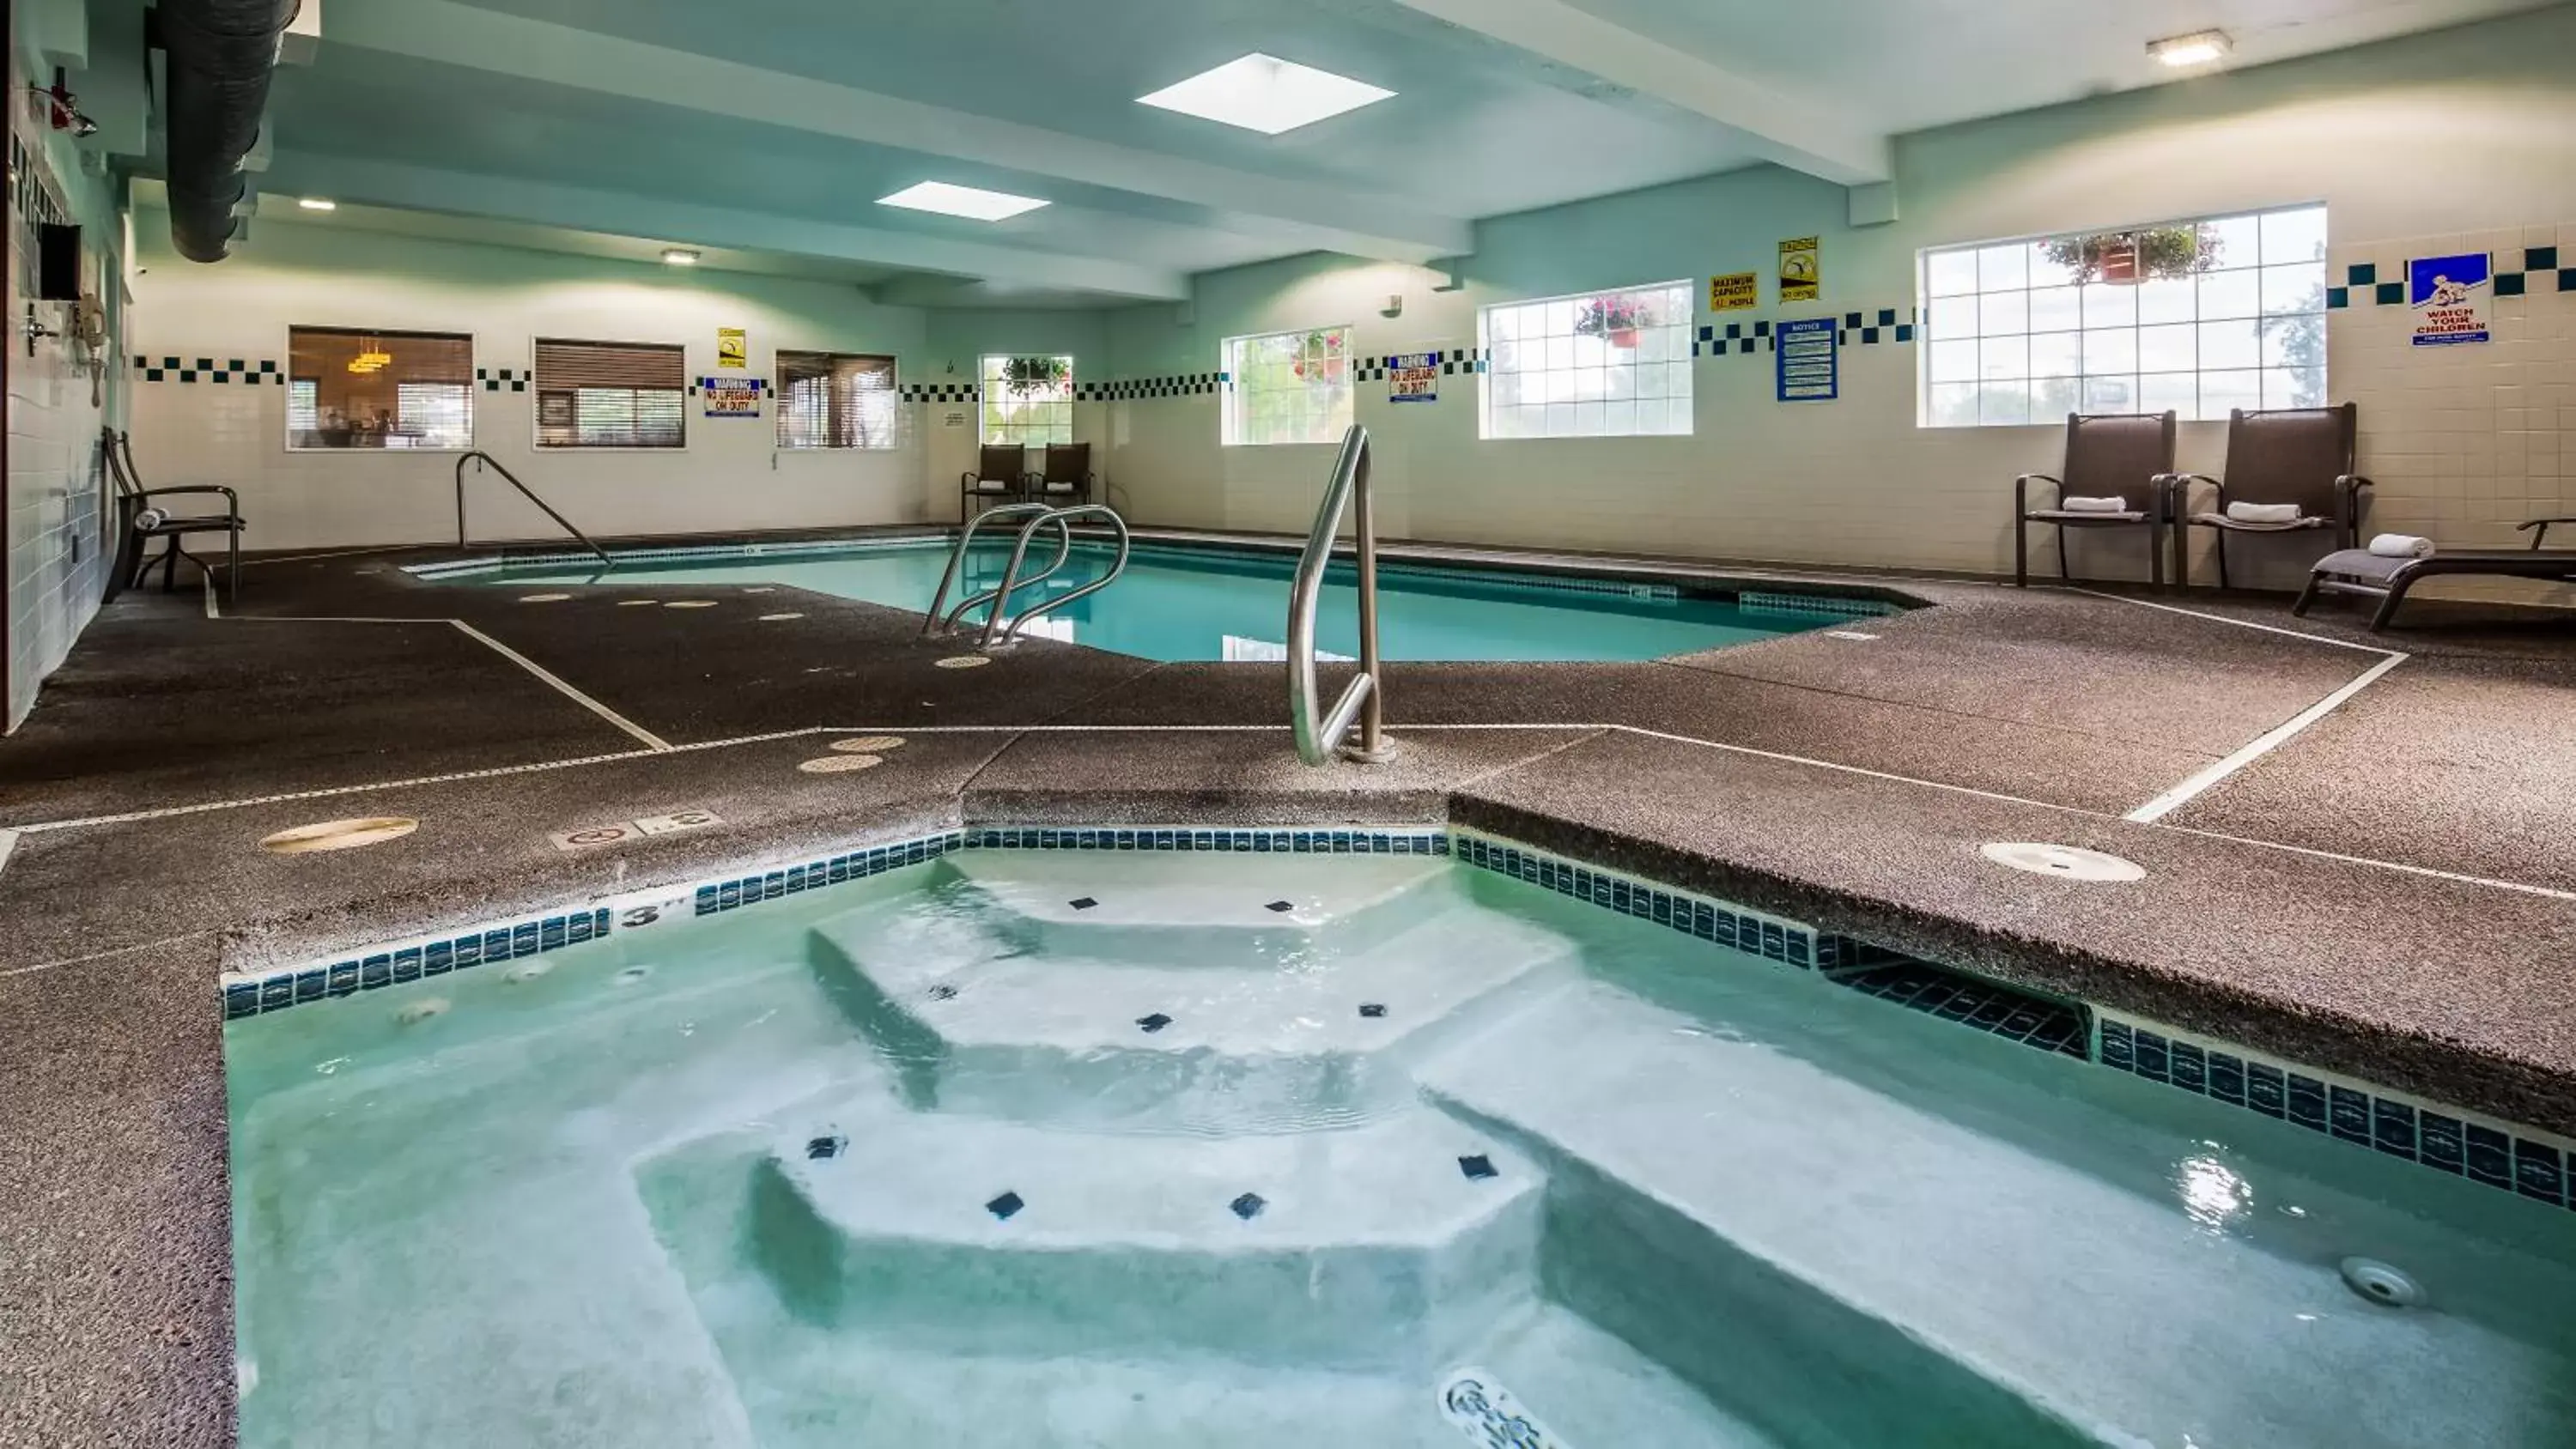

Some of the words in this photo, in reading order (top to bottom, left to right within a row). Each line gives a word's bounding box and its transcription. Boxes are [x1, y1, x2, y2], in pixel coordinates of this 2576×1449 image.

[1714, 276, 1753, 288] MAXIMUM
[1714, 286, 1753, 297] CAPACITY
[2427, 309, 2474, 318] WATCH
[2432, 317, 2470, 325] YOUR
[1792, 322, 1820, 331] NOTICE
[2416, 322, 2486, 334] CHILDREN
[714, 379, 751, 390] WARNING
[729, 401, 750, 411] DUTY
